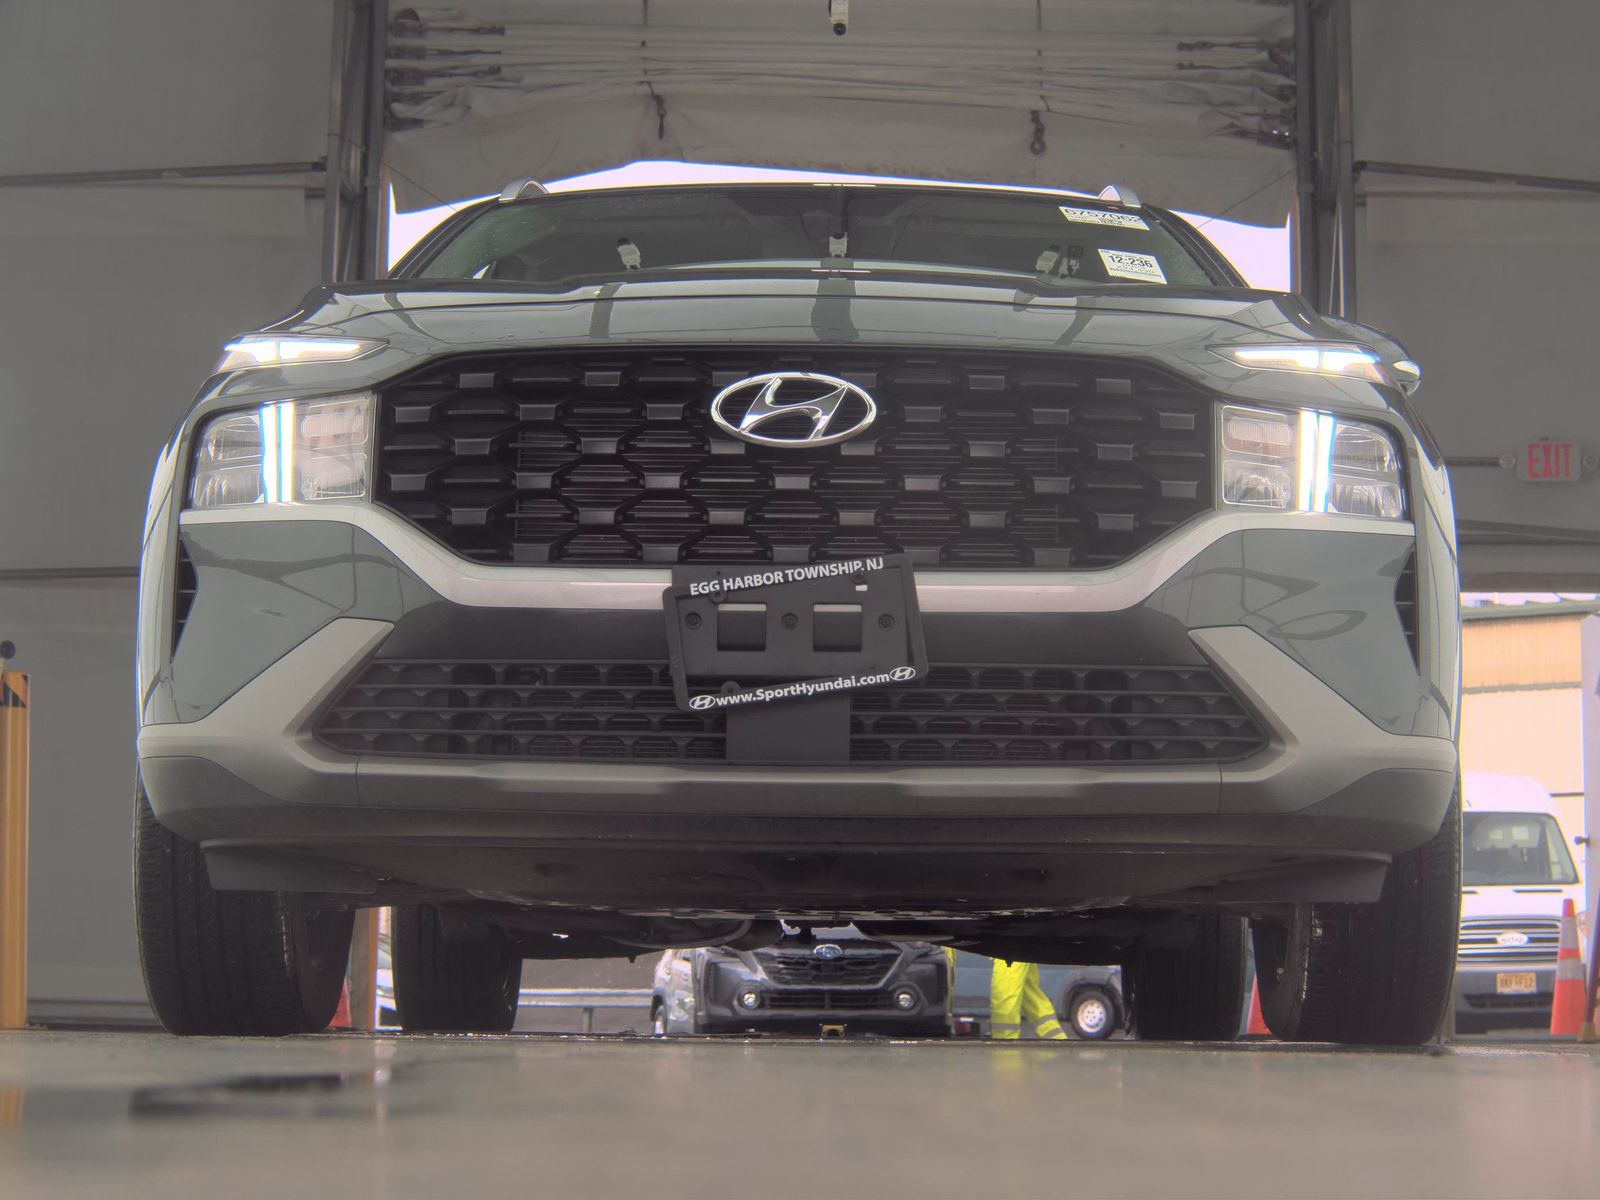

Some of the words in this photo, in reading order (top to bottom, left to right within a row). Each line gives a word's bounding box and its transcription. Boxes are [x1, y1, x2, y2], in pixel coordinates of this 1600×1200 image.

[1108, 255, 1153, 268] 12-236
[1527, 442, 1574, 478] EXIT
[690, 580, 720, 596] EGG
[723, 571, 784, 591] HARBOR
[865, 557, 884, 571] NJ
[716, 672, 890, 706] www.SportHyundai.com
